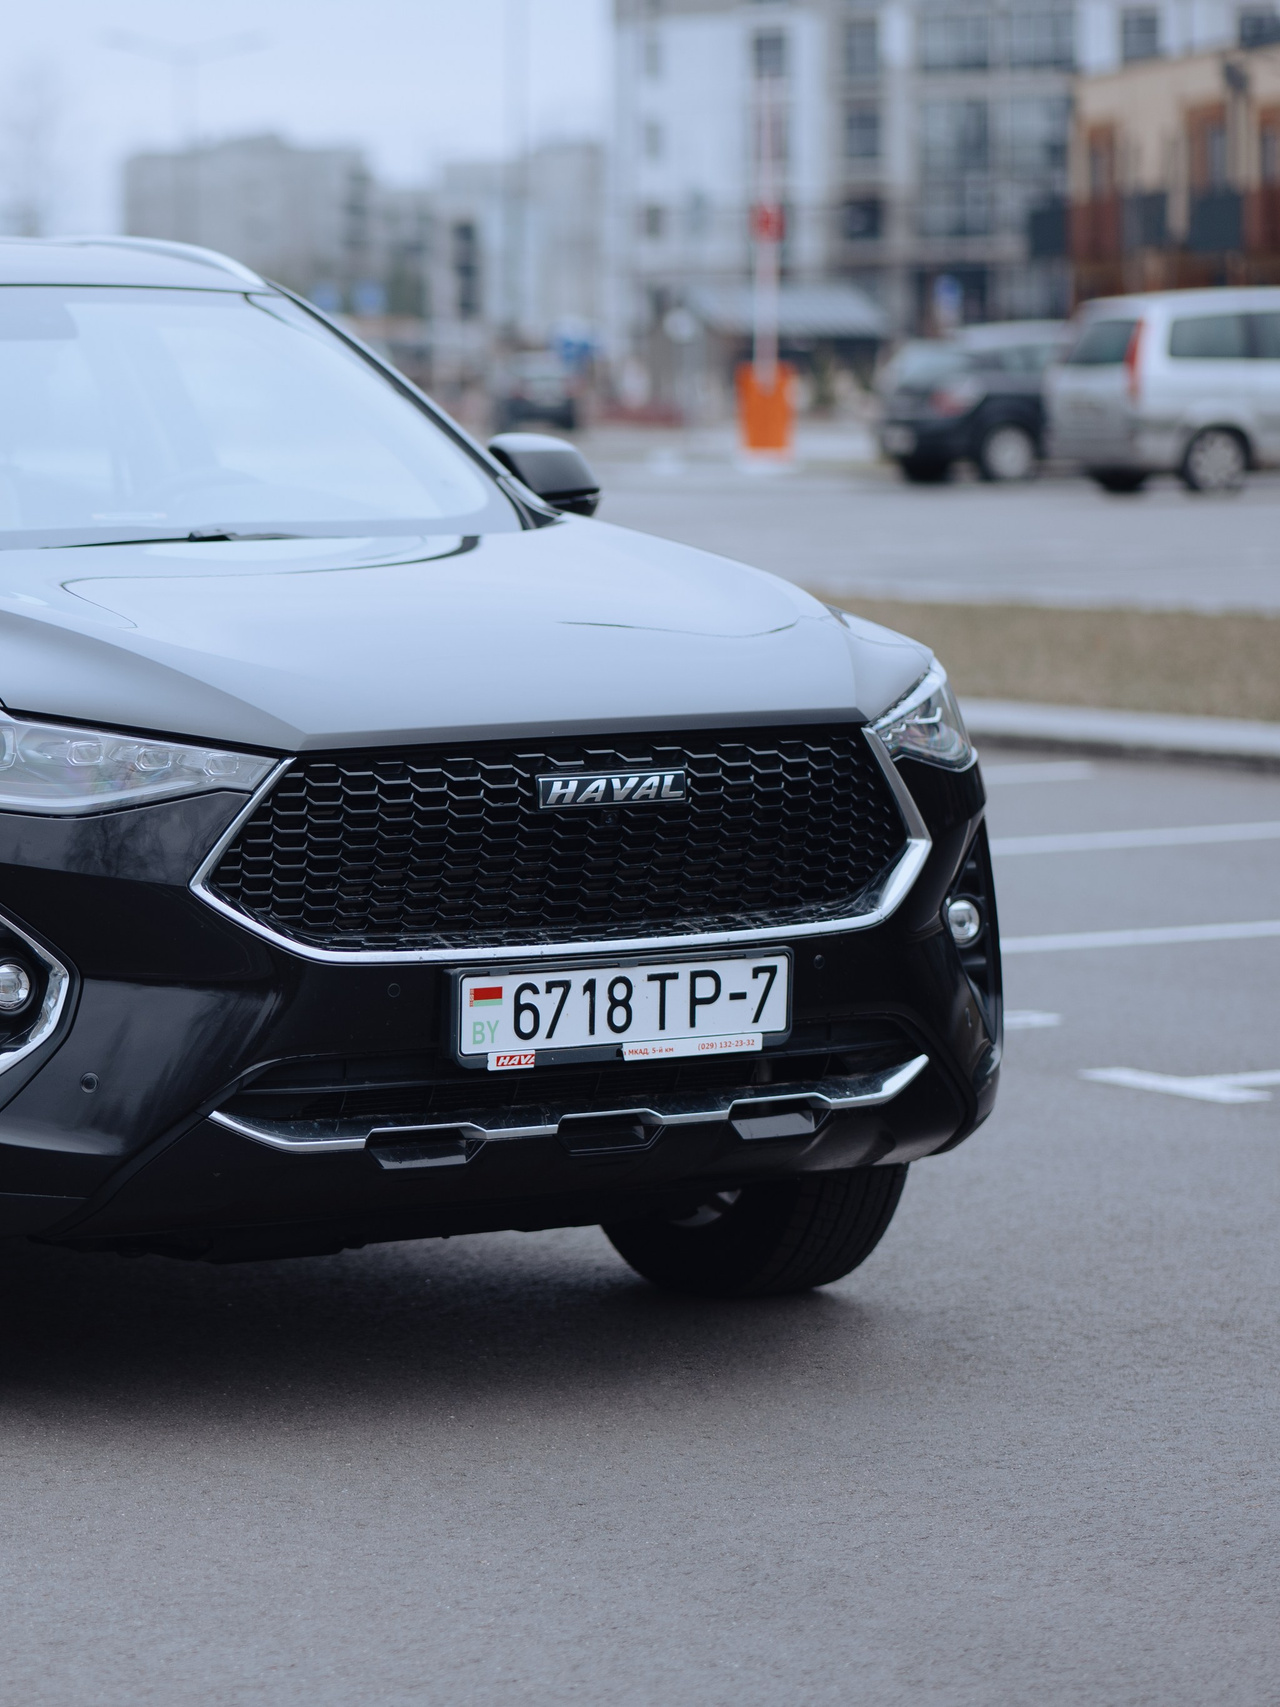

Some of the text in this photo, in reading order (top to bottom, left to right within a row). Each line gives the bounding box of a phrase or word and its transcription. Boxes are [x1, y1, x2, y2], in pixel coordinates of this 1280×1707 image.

[546, 775, 683, 804] HAVAL
[472, 1020, 499, 1045] BY
[697, 1042, 717, 1051] (029)
[719, 1039, 755, 1049] 132-23-32
